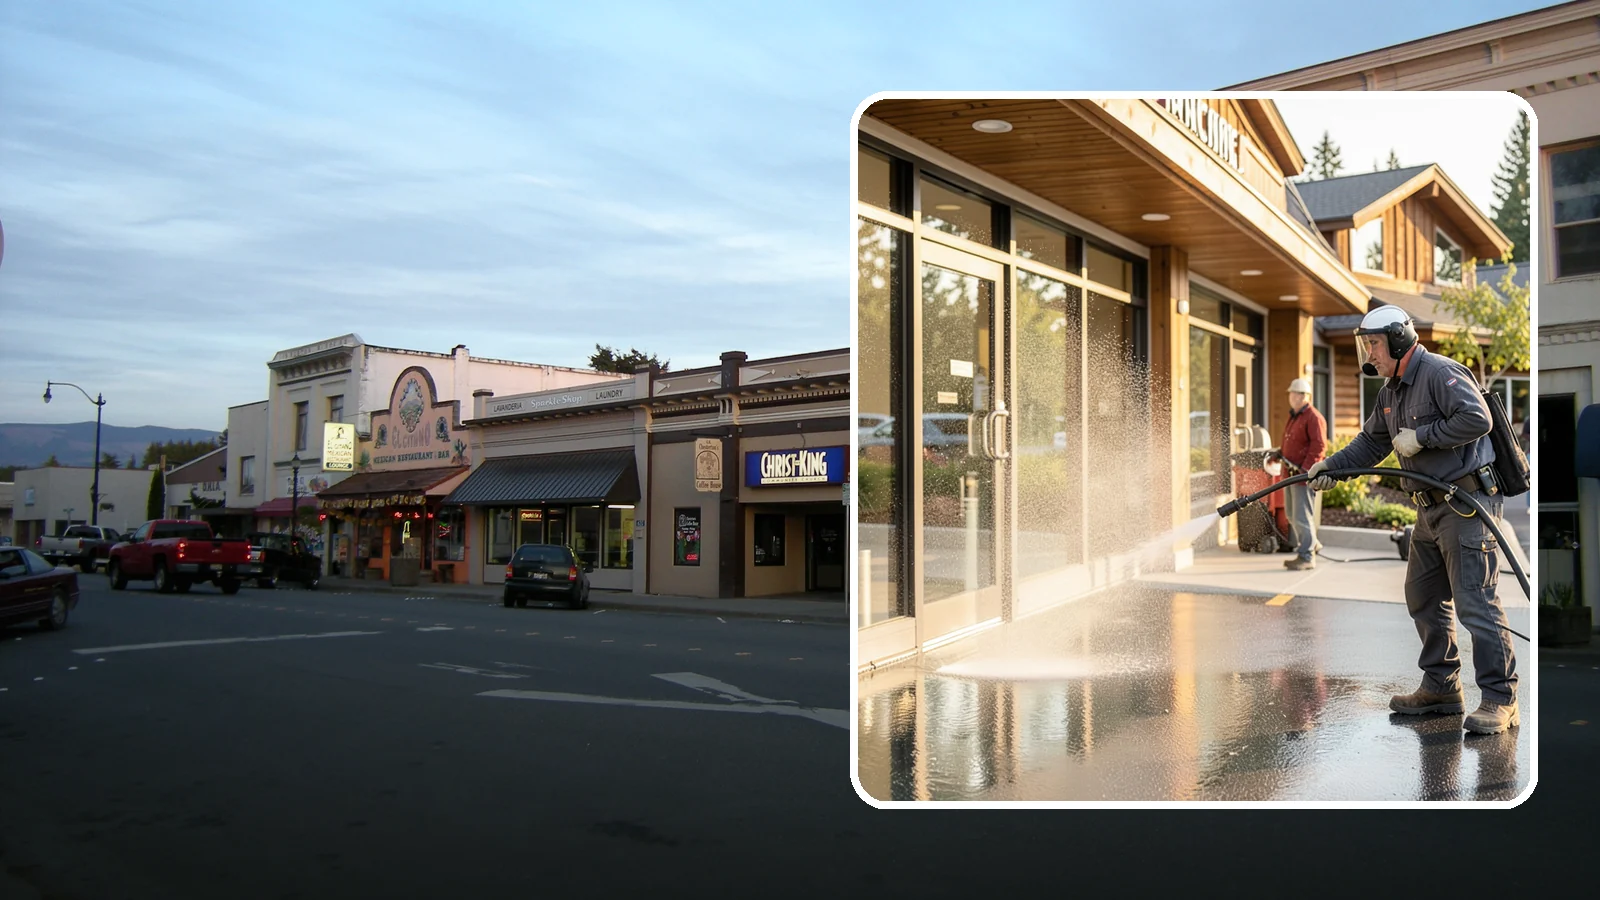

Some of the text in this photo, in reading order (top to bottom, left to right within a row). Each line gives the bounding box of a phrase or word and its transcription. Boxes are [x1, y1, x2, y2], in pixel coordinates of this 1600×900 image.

[493, 389, 624, 413] LAVANDERIA Sparkle Shop LAUNDRY
[397, 452, 433, 462] RESTAURANT
[438, 450, 450, 458] BAR
[761, 450, 827, 478] CHRIST KING
